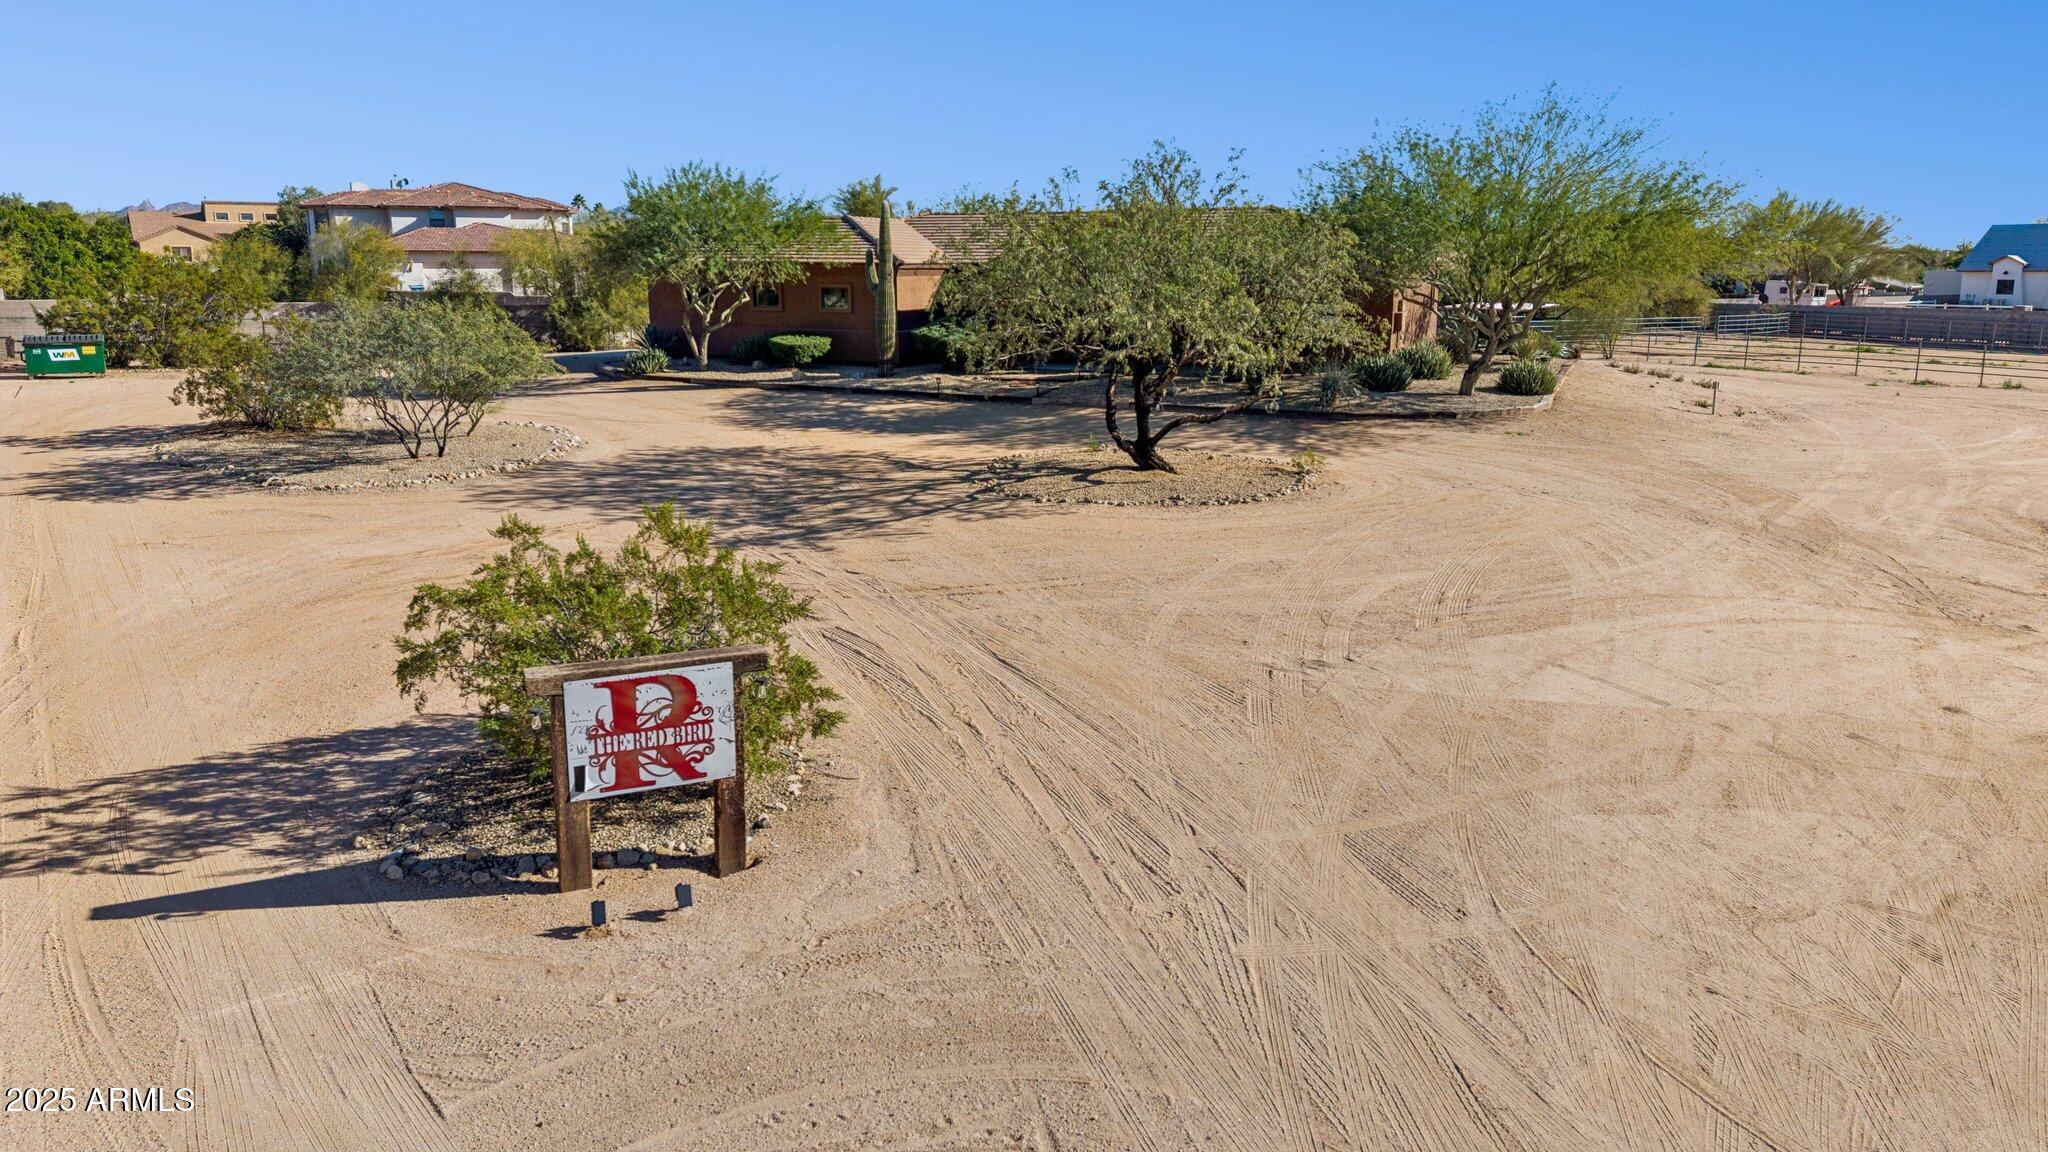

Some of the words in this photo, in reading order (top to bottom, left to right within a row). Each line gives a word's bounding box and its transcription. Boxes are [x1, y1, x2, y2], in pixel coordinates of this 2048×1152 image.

[593, 674, 708, 793] R
[593, 734, 632, 756] THE
[633, 728, 668, 750] RED
[672, 722, 714, 744] BIRD
